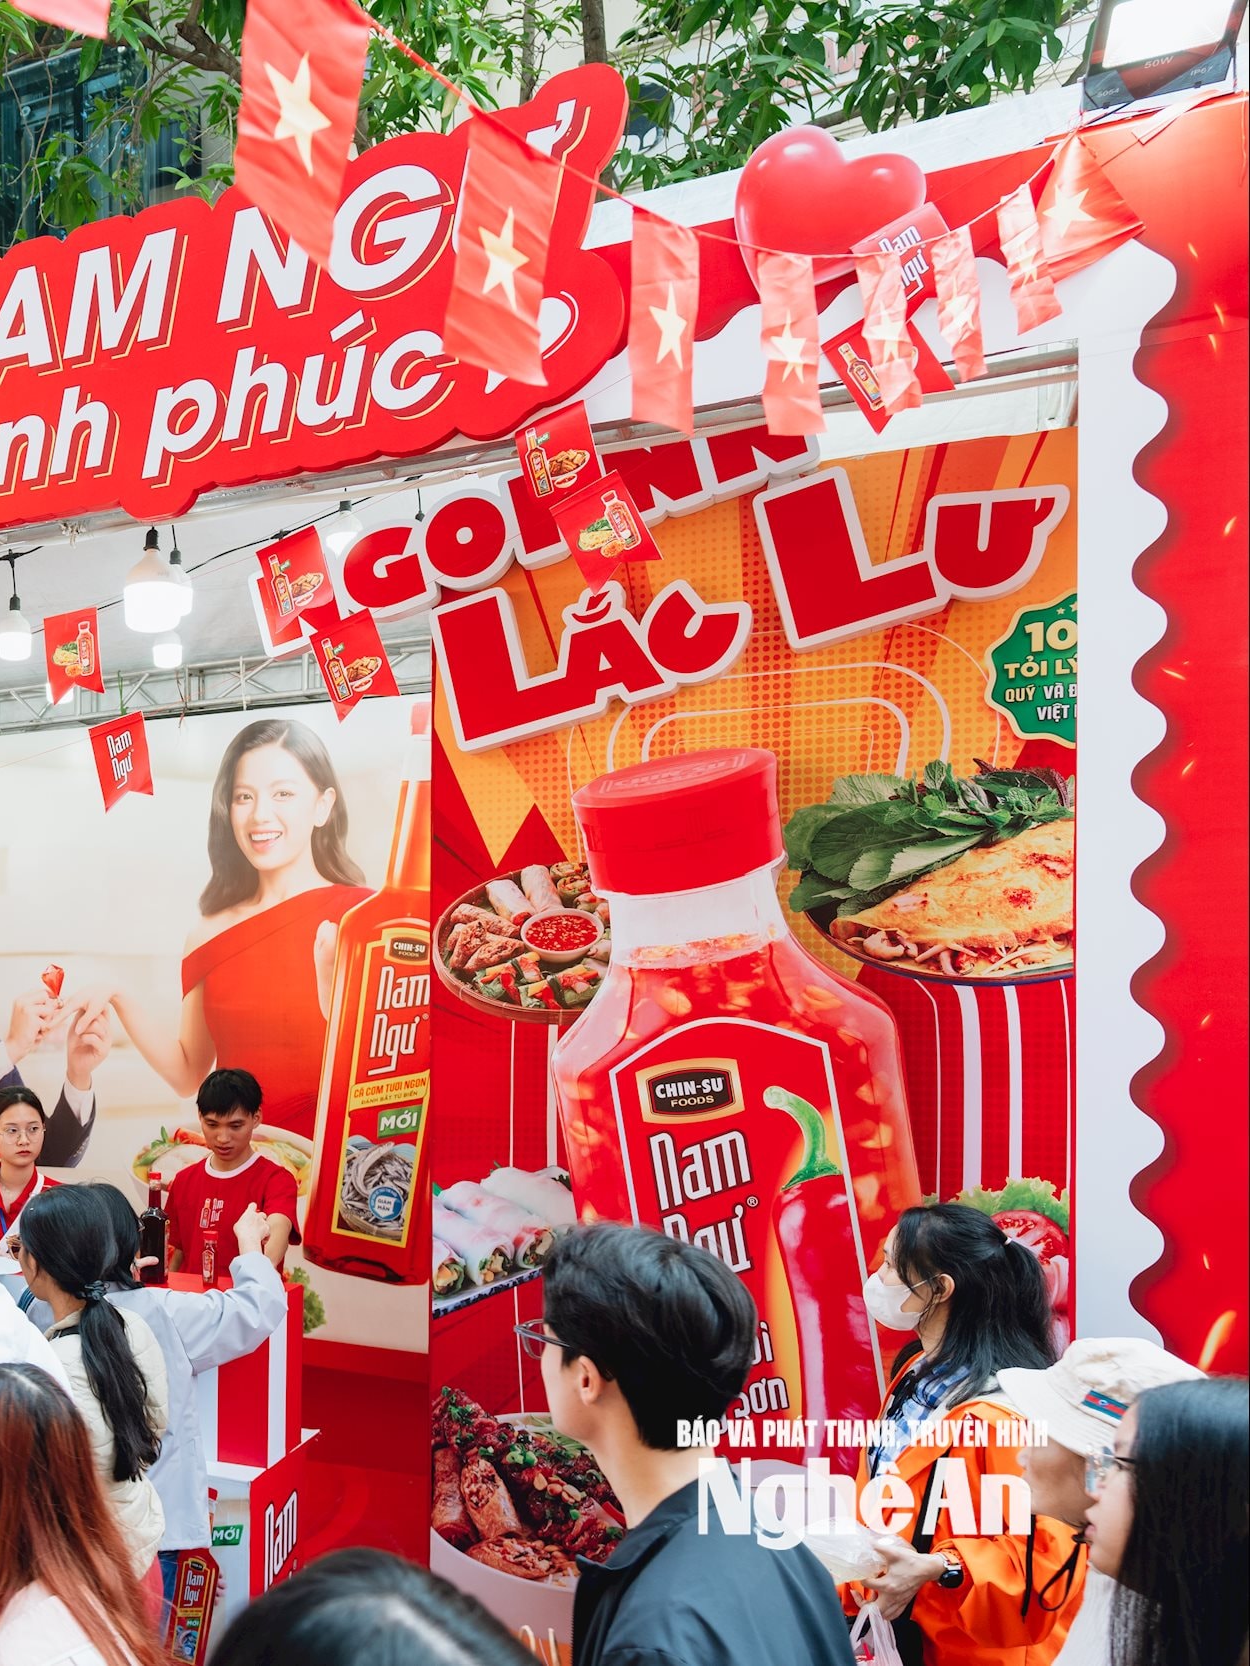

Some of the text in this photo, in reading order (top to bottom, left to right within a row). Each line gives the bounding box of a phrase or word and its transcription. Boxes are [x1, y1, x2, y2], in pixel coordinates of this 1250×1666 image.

[216, 99, 577, 325] NG
[141, 310, 445, 480] phúc
[436, 475, 1056, 743] LẮC LƯ
[1003, 655, 1048, 679] TỎI
[1004, 684, 1036, 703] QUÝ
[1036, 703, 1071, 723] VIỆT
[106, 730, 132, 759] Nam
[393, 941, 426, 953] CHIN-SU
[376, 965, 430, 1011] Nam
[655, 1076, 724, 1099] CHIN-SU
[670, 1095, 715, 1108] FOODS
[379, 1110, 418, 1132] MỚI
[650, 1130, 751, 1211] Nam
[212, 1526, 240, 1541] MỚI
[264, 1490, 298, 1593] Nam
